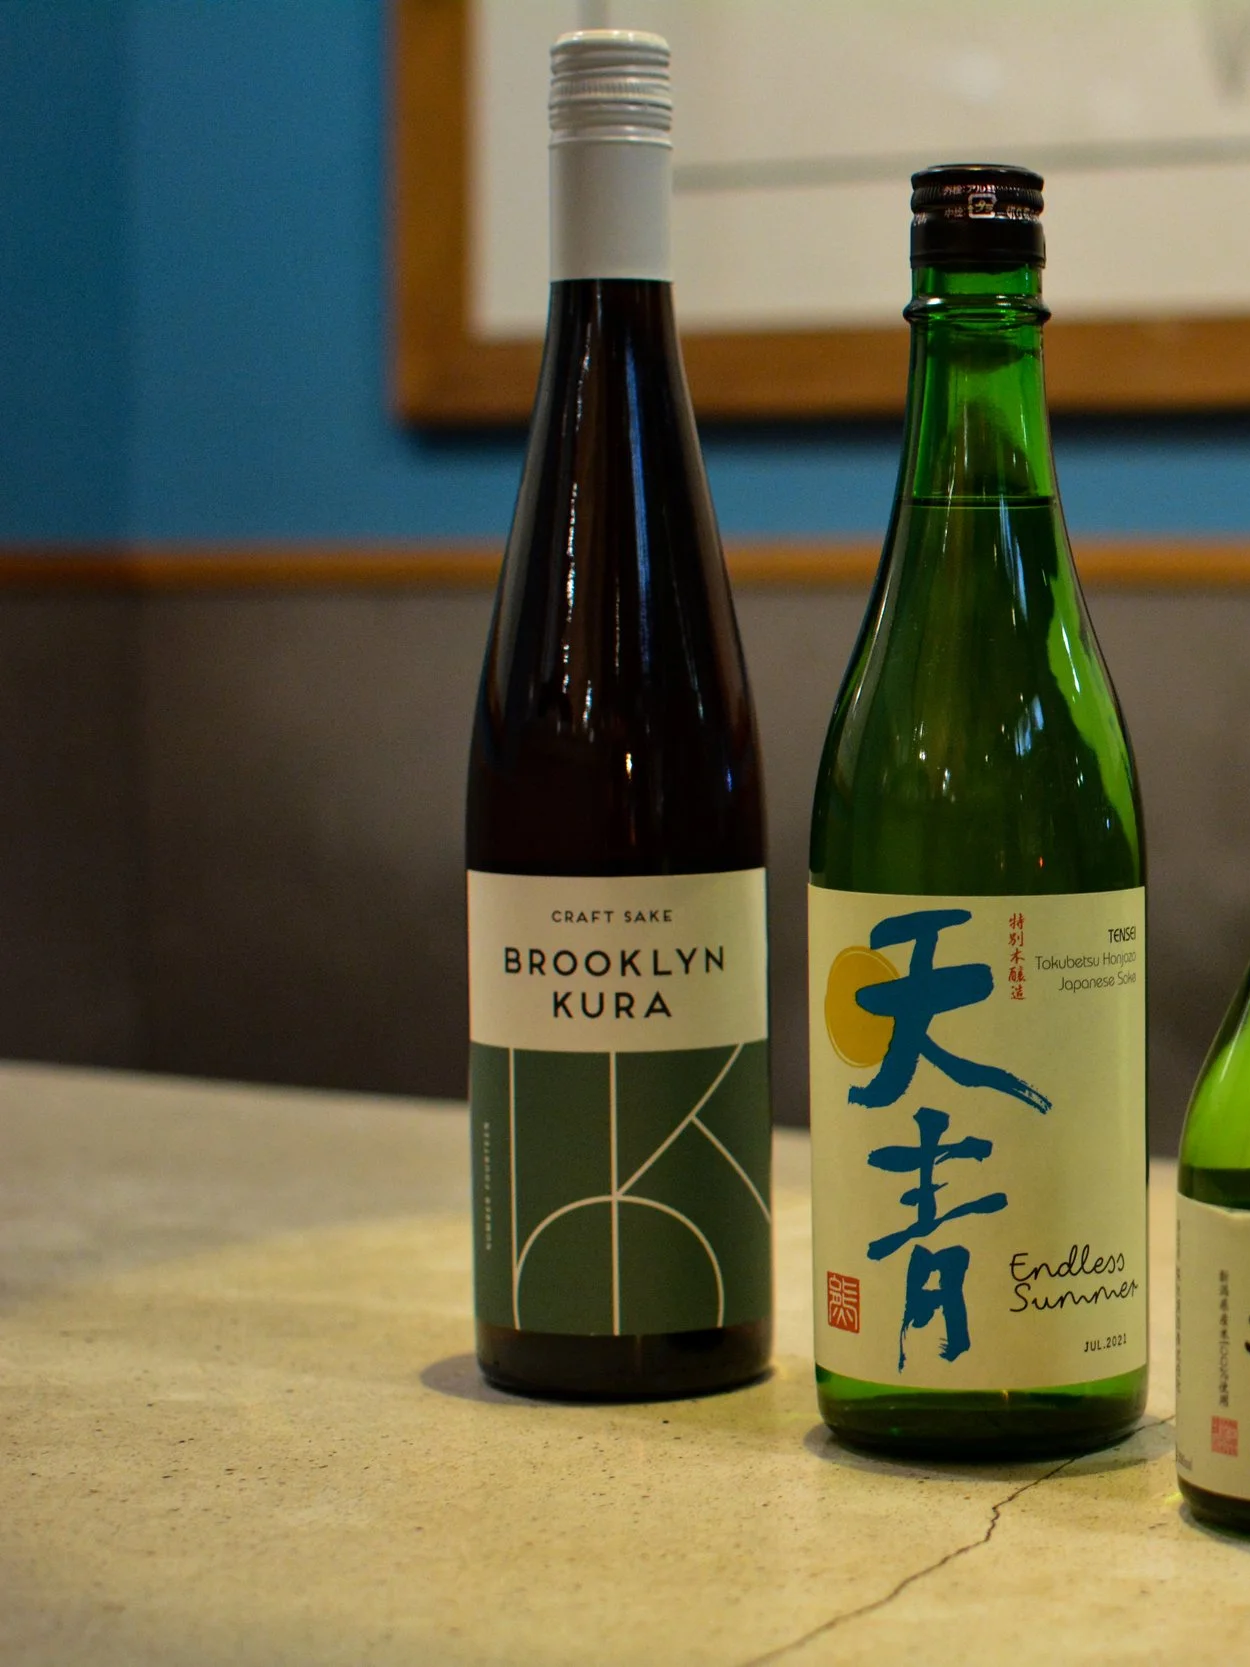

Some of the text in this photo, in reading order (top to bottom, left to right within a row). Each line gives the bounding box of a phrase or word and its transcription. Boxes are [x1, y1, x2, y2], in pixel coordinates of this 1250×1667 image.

[551, 909, 673, 923] CRAFT SAKE
[504, 946, 724, 976] BROOKLYN
[1035, 955, 1100, 970] Tokubetsu
[1058, 971, 1136, 993] Japanese Sake
[553, 991, 672, 1019] KURA
[1009, 1244, 1125, 1282] Endless
[1009, 1279, 1138, 1312] Summer
[1084, 1333, 1127, 1353] JUL.2021
